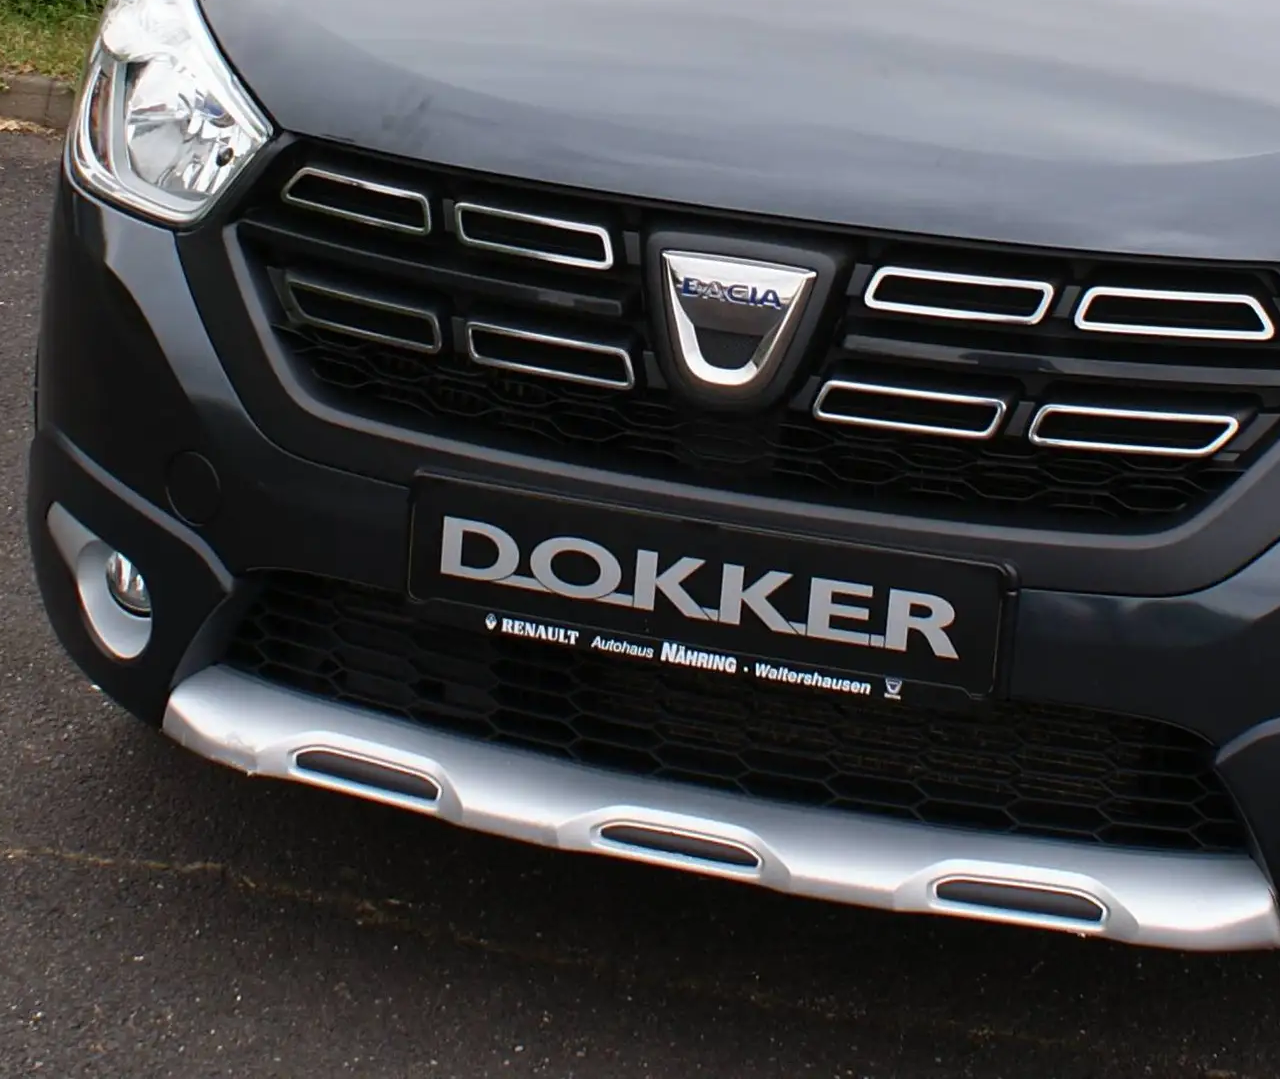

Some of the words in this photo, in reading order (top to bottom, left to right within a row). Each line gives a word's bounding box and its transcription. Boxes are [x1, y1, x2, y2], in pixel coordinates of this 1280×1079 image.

[681, 277, 781, 309] DACIA
[439, 514, 960, 660] DOKKER
[501, 617, 580, 646] RENAULT
[590, 635, 655, 659] Autohaus
[660, 641, 738, 673] NÄHRING
[754, 662, 872, 695] Waltershausen
